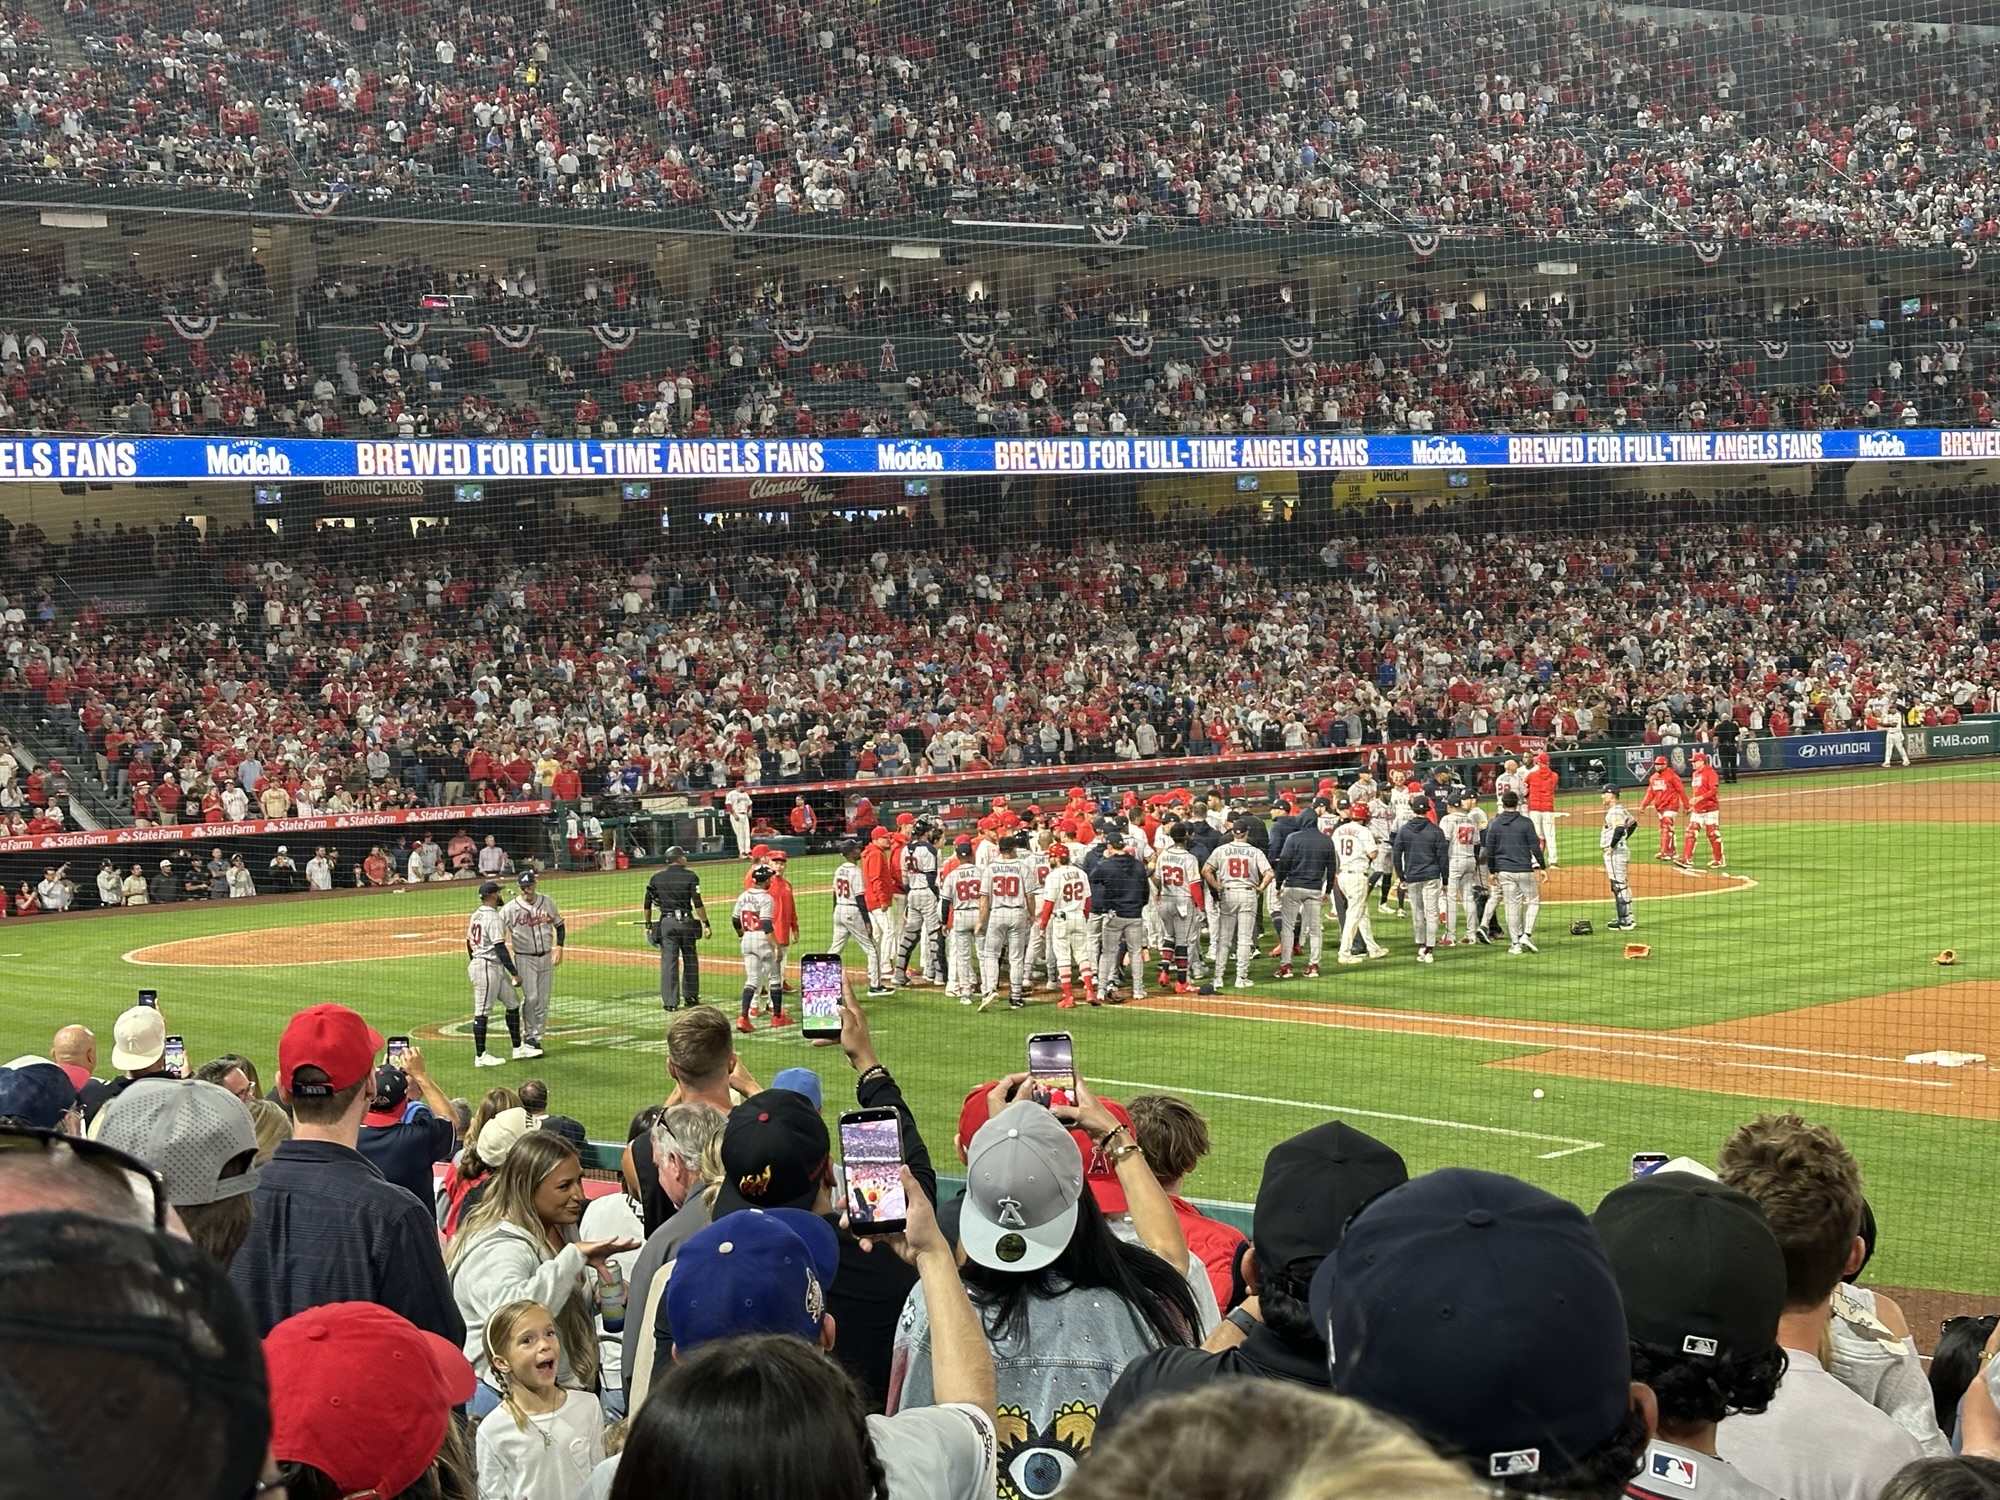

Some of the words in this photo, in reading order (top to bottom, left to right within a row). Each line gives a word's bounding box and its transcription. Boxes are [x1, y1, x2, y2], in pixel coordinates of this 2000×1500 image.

[995, 440, 1085, 470] BREWED
[1090, 440, 1130, 469] FOR
[1134, 440, 1237, 468] FULL-TIME
[1241, 439, 1316, 468] ANGELS
[1320, 438, 1369, 466] FANS
[1412, 440, 1467, 464] Modelo
[1509, 437, 1584, 464] BREWED
[1588, 436, 1621, 463] FOR
[1624, 435, 1711, 462] FULL-TIME
[1715, 434, 1778, 460] ANGELS
[1781, 433, 1823, 459] FANS
[1859, 434, 1906, 456] Modelo
[60, 442, 137, 477] FANS
[207, 446, 290, 475] Modelo
[357, 443, 471, 475] BREWED
[478, 443, 529, 475] FOR
[534, 442, 662, 474] FULL-TIME
[668, 442, 761, 474] ANGELS
[765, 442, 826, 474] FANS
[878, 444, 943, 471] Modelo
[1372, 470, 1409, 482] PORCH
[323, 480, 382, 496] CHRONIC
[384, 480, 424, 495] TACOS
[749, 477, 808, 500] Classic
[1820, 742, 1870, 756] HYUNDAI
[1933, 734, 1990, 747] FMB.com
[1628, 751, 1651, 762] MLB
[1225, 849, 1255, 858] GARNEAU
[1340, 838, 1354, 857] 18
[521, 874, 528, 882] A
[1162, 865, 1184, 886] 23
[1229, 858, 1251, 878] 81
[956, 879, 981, 901] 83
[993, 876, 1020, 897] 30
[1063, 881, 1084, 902] 92
[998, 1196, 1026, 1227] A
